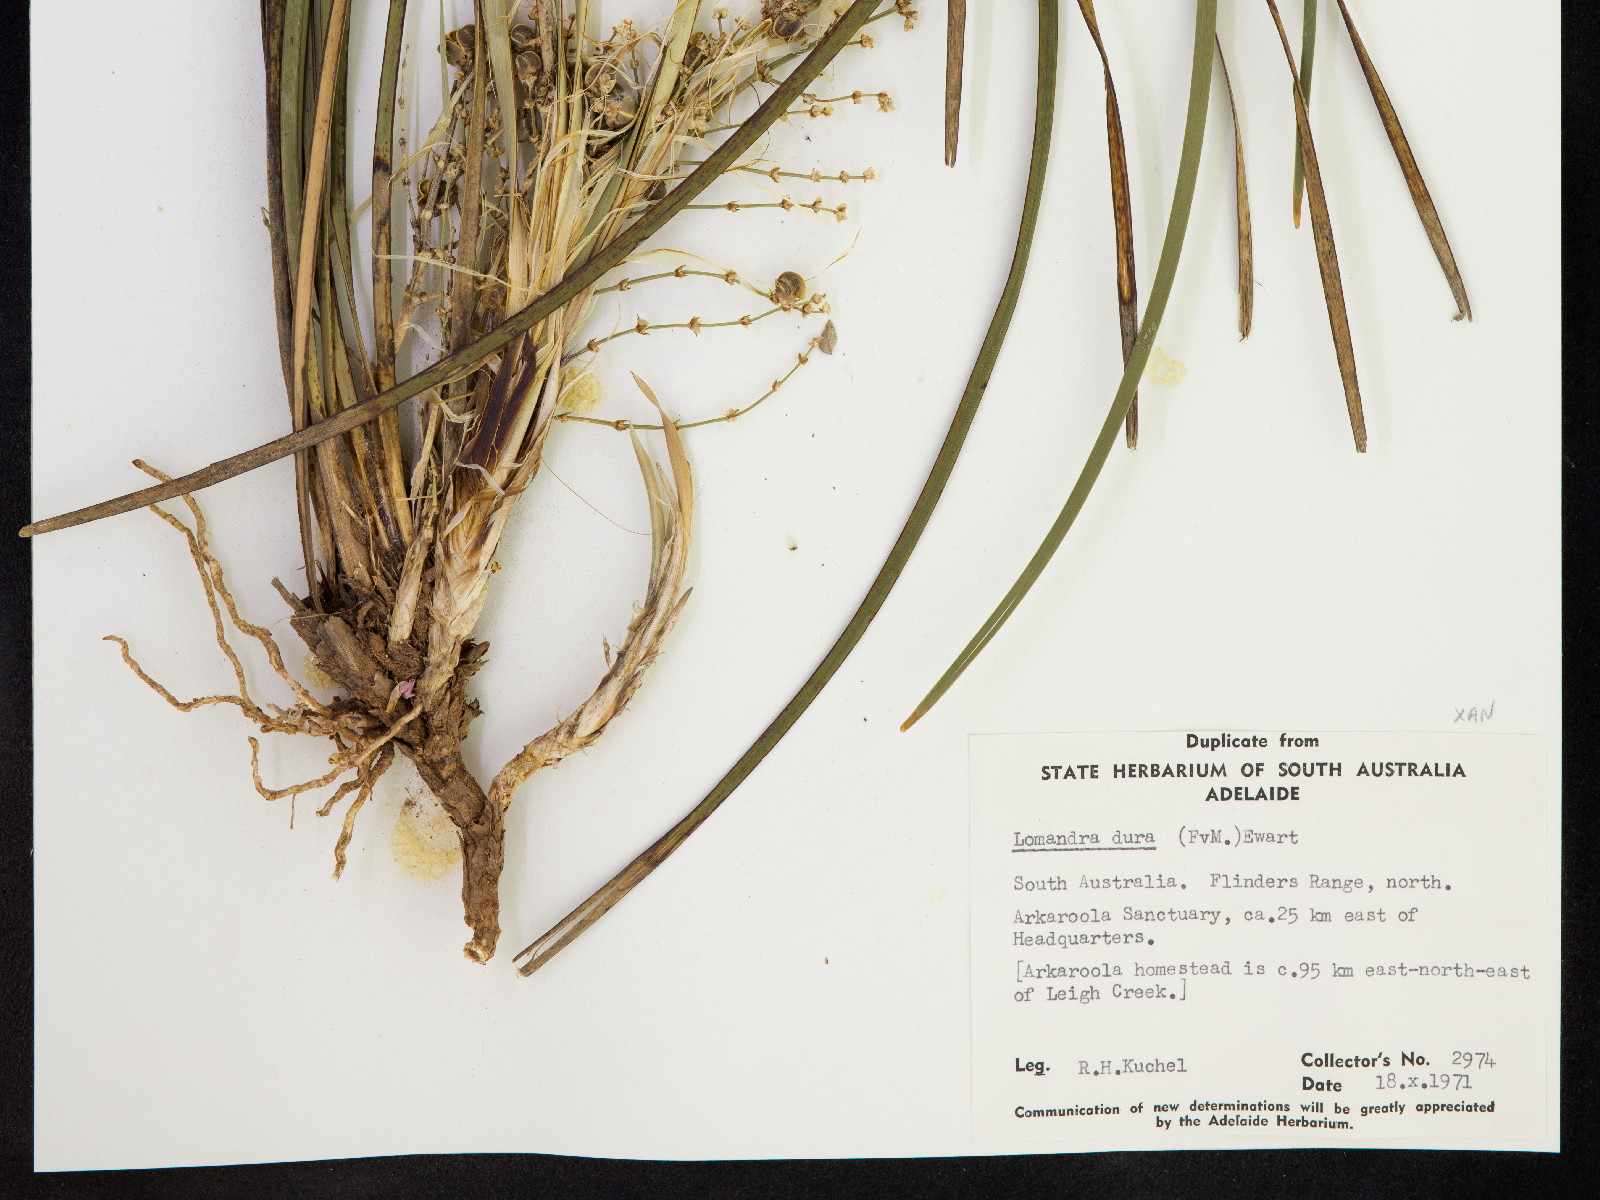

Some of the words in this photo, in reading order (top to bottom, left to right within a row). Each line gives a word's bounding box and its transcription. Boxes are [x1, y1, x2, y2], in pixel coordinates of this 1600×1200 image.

[1187, 733, 1267, 751] Duplicate
[1280, 733, 1319, 747] from
[1042, 765, 1098, 780] STATE
[1114, 763, 1227, 778] HERBARIUM
[1241, 763, 1264, 777] OF
[1279, 762, 1341, 777] SOUTH
[1356, 762, 1466, 777] AUSTRALIA
[1205, 786, 1299, 801] ADELAIDE
[1014, 831, 1100, 846] Lomandra
[1112, 830, 1155, 844] dura
[1014, 876, 1067, 891] South
[1079, 874, 1186, 889] Australia.
[1210, 873, 1298, 888] Flinders
[1309, 874, 1373, 893] Range,
[1386, 875, 1451, 890] north.
[1013, 909, 1111, 924] Arkaroola
[1124, 907, 1230, 925] Sanctuary,
[1244, 906, 1298, 924] ca.25
[1310, 908, 1332, 922] km
[1345, 908, 1386, 922] east
[1398, 907, 1418, 922] of
[1013, 931, 1154, 949] Headquarters.
[1017, 960, 1123, 982] [Arkaroola
[1134, 961, 1232, 979] homestead
[1244, 961, 1265, 975] is
[1278, 962, 1320, 979] c.95
[1332, 963, 1354, 977] km
[1366, 963, 1530, 979] east-north-east
[1014, 987, 1034, 1002] of
[1047, 985, 1100, 1004] Leigh
[1112, 978, 1186, 1001] Creek.]
[1016, 1058, 1050, 1076] Leg.
[1078, 1058, 1187, 1076] R.H.Kuchel
[1301, 1052, 1390, 1068] Collector's
[1402, 1051, 1430, 1066] No.
[1452, 1051, 1496, 1069] 2974
[1302, 1076, 1342, 1092] Date
[1376, 1073, 1472, 1090] 18.x.1971
[1015, 1104, 1119, 1118] Communication
[1130, 1102, 1143, 1113] of
[1154, 1104, 1180, 1112] new
[1190, 1100, 1290, 1116] determinations
[1300, 1102, 1323, 1113] will
[1334, 1102, 1350, 1114] be
[1361, 1101, 1405, 1116] greatly
[1416, 1101, 1495, 1114] appreciated
[1156, 1116, 1172, 1130] by
[1179, 1115, 1200, 1126] the
[1208, 1114, 1268, 1126] Adelaide
[1277, 1115, 1353, 1129] Herbarium.
